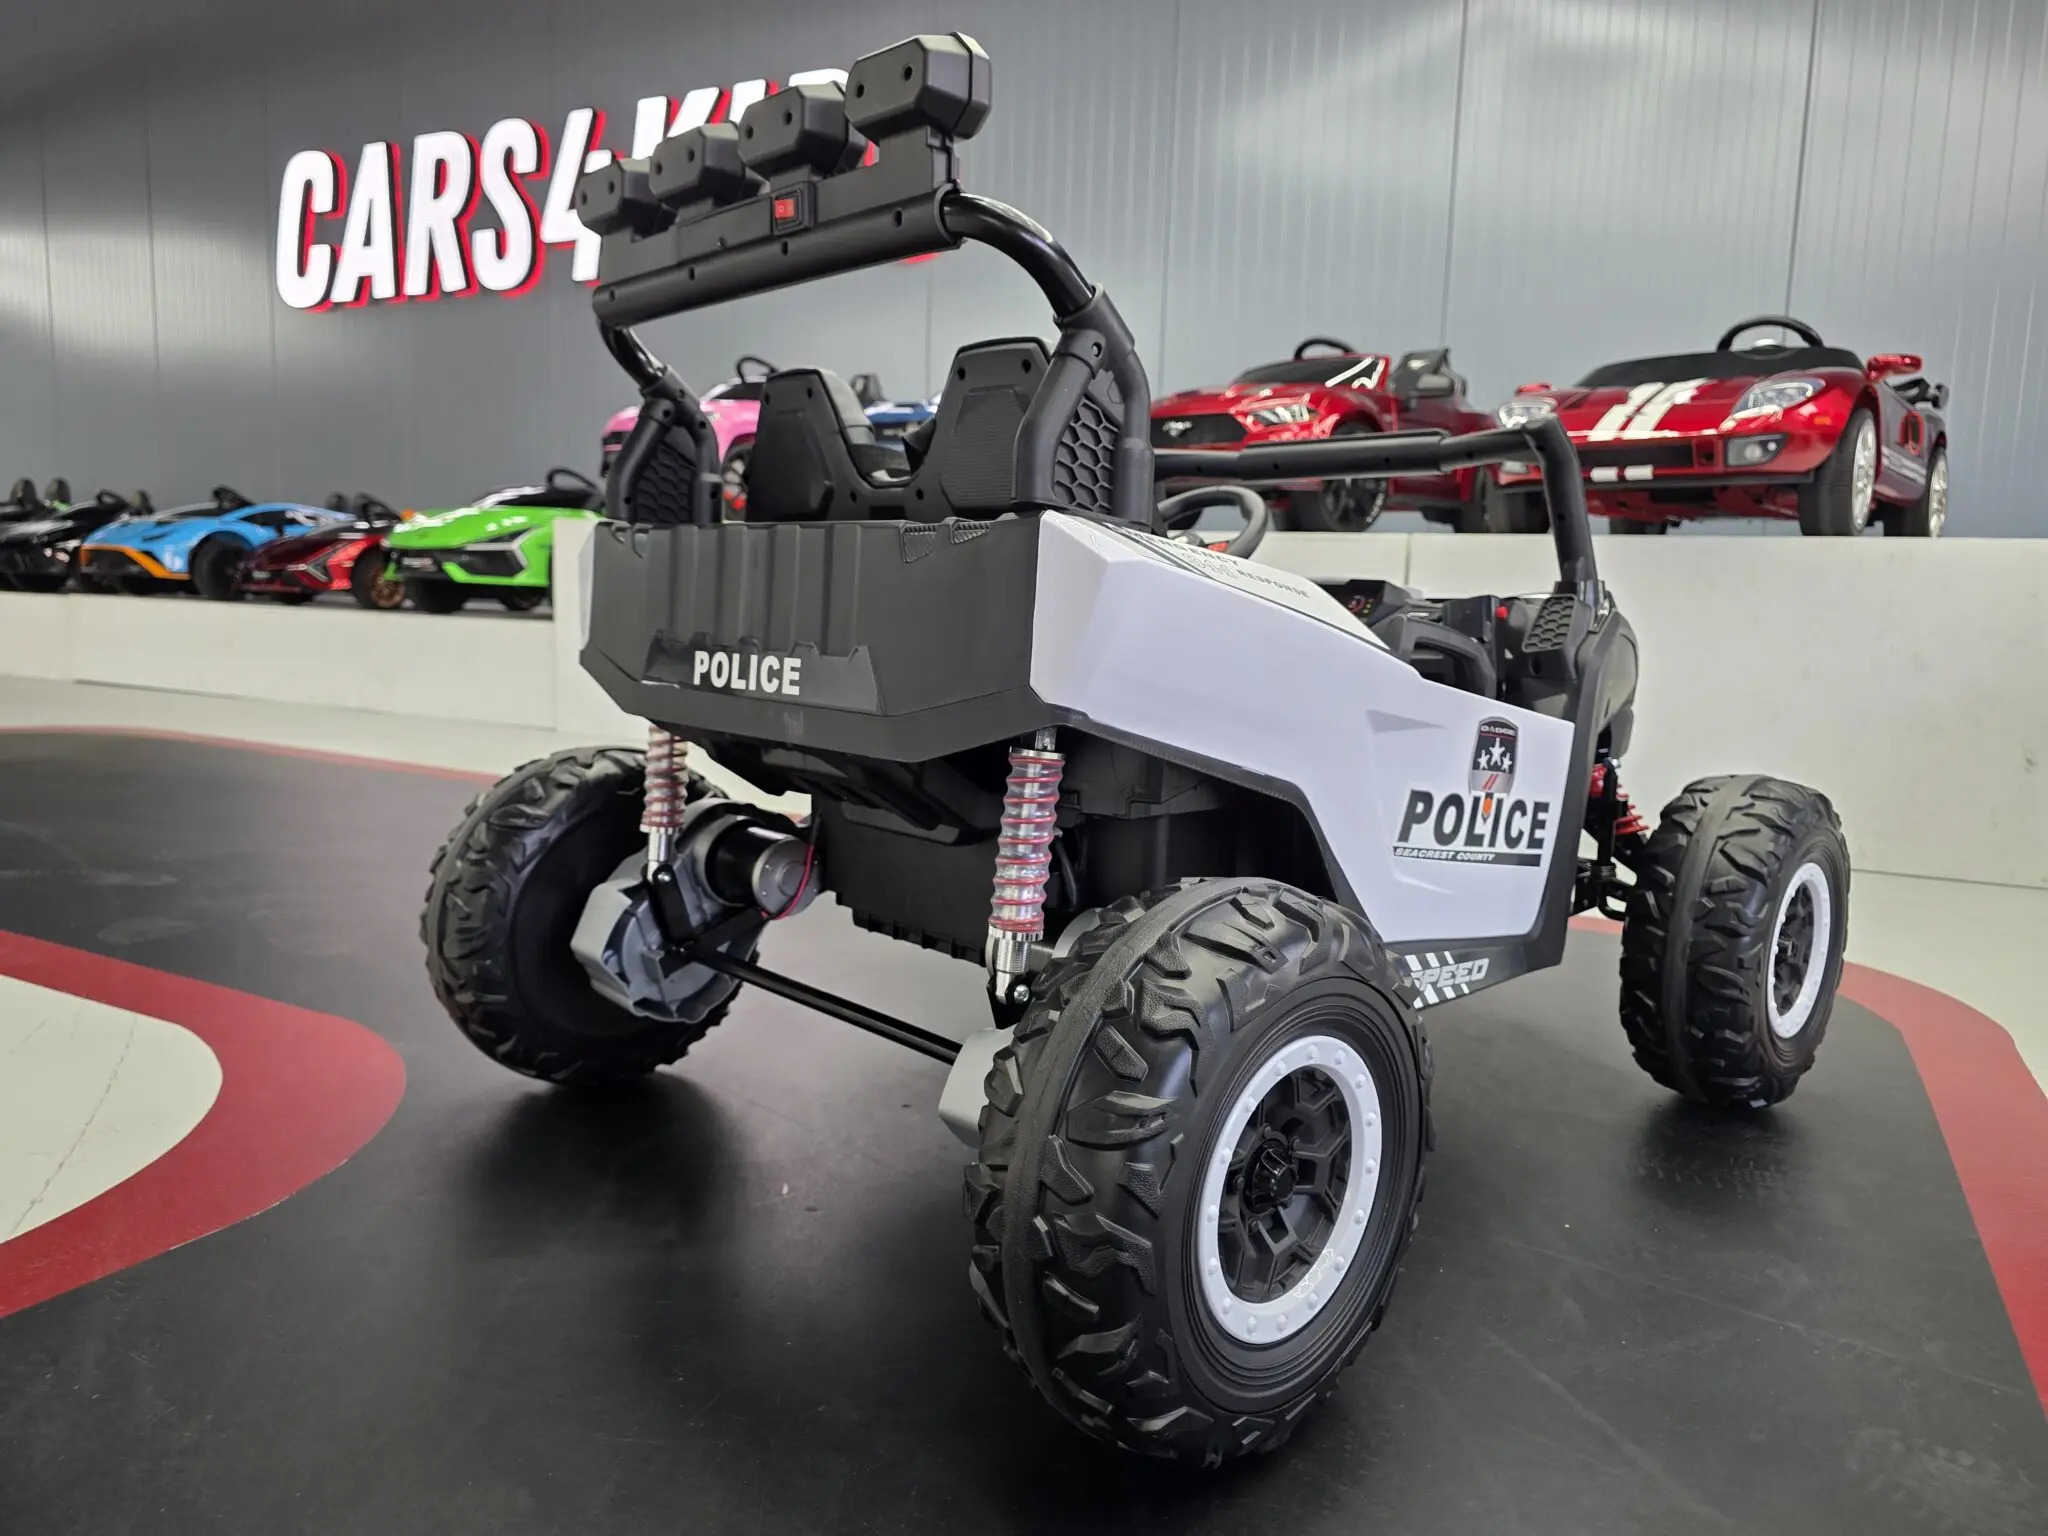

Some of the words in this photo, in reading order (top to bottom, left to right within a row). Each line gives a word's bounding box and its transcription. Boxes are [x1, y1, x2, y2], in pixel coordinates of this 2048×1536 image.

[693, 650, 801, 696] POLICE
[1396, 789, 1550, 849] POLICE
[1394, 847, 1455, 860] SEACREST
[1456, 852, 1496, 862] COUNTY
[1410, 958, 1490, 991] SPEED
